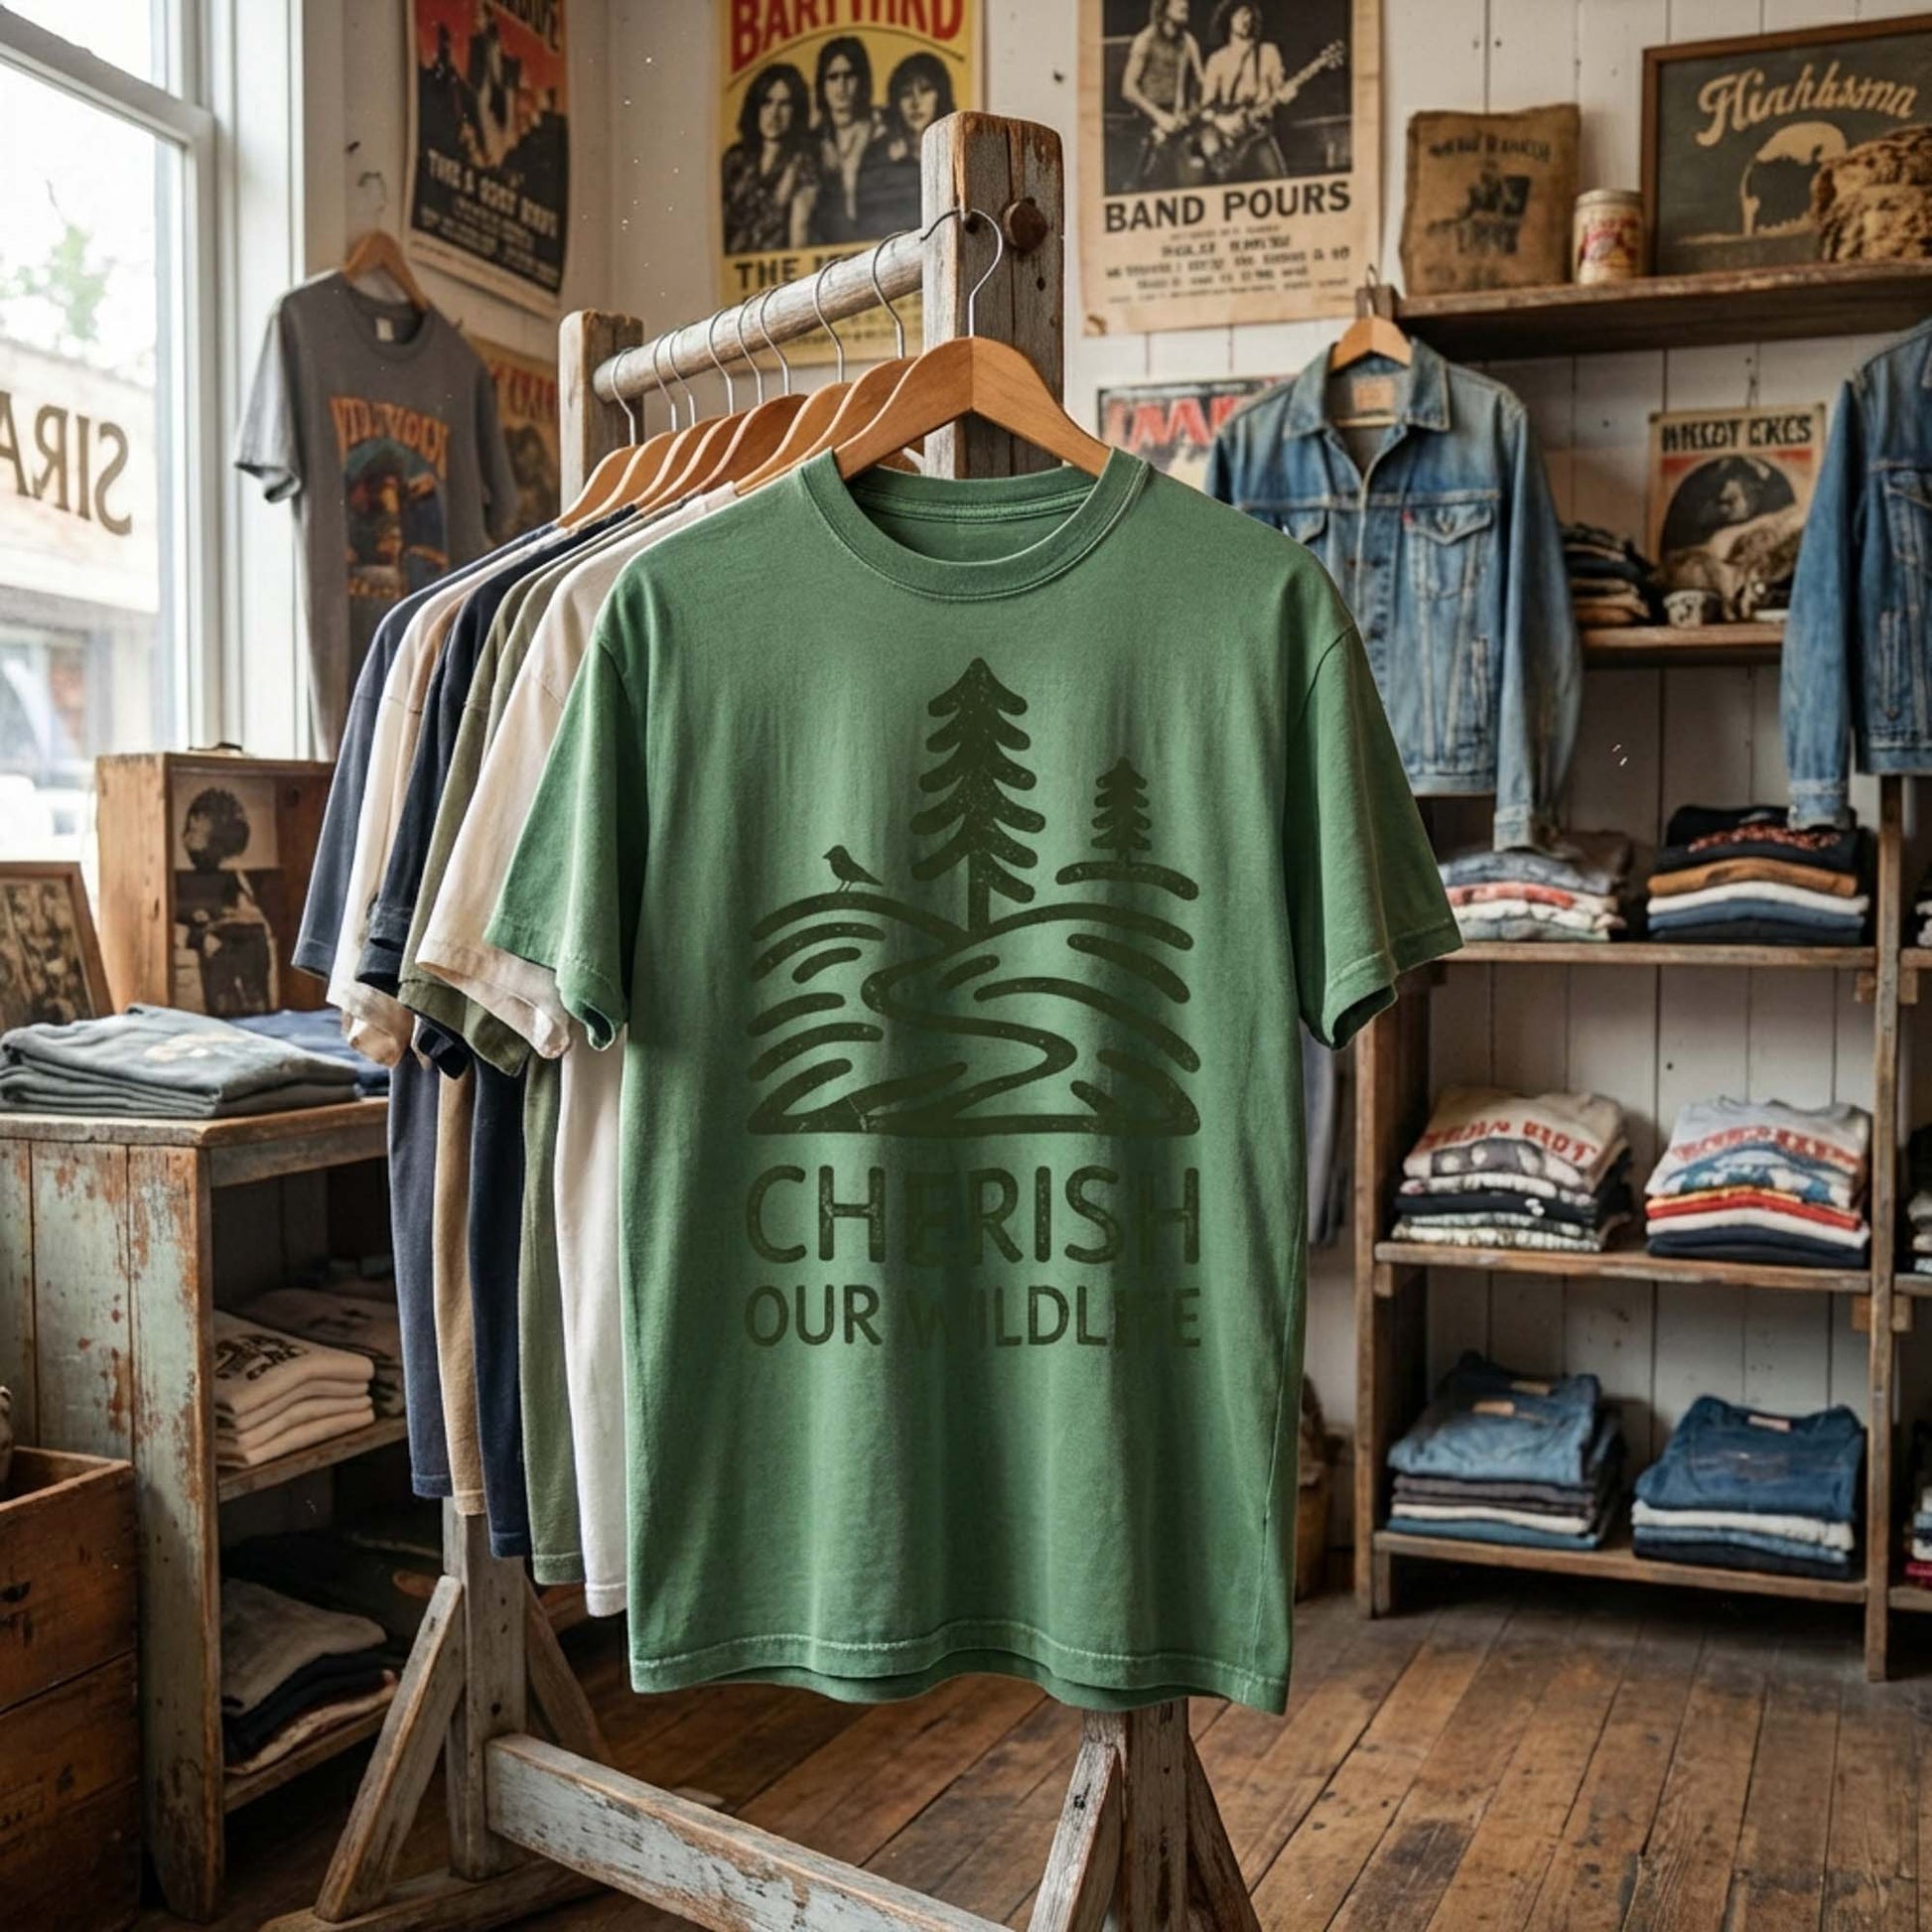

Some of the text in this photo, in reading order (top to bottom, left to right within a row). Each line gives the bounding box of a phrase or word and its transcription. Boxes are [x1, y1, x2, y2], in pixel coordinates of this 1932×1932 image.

[1104, 181, 1351, 233] BAND POURS
[746, 1165, 1199, 1266] CHERISH
[745, 1284, 882, 1346] OUR
